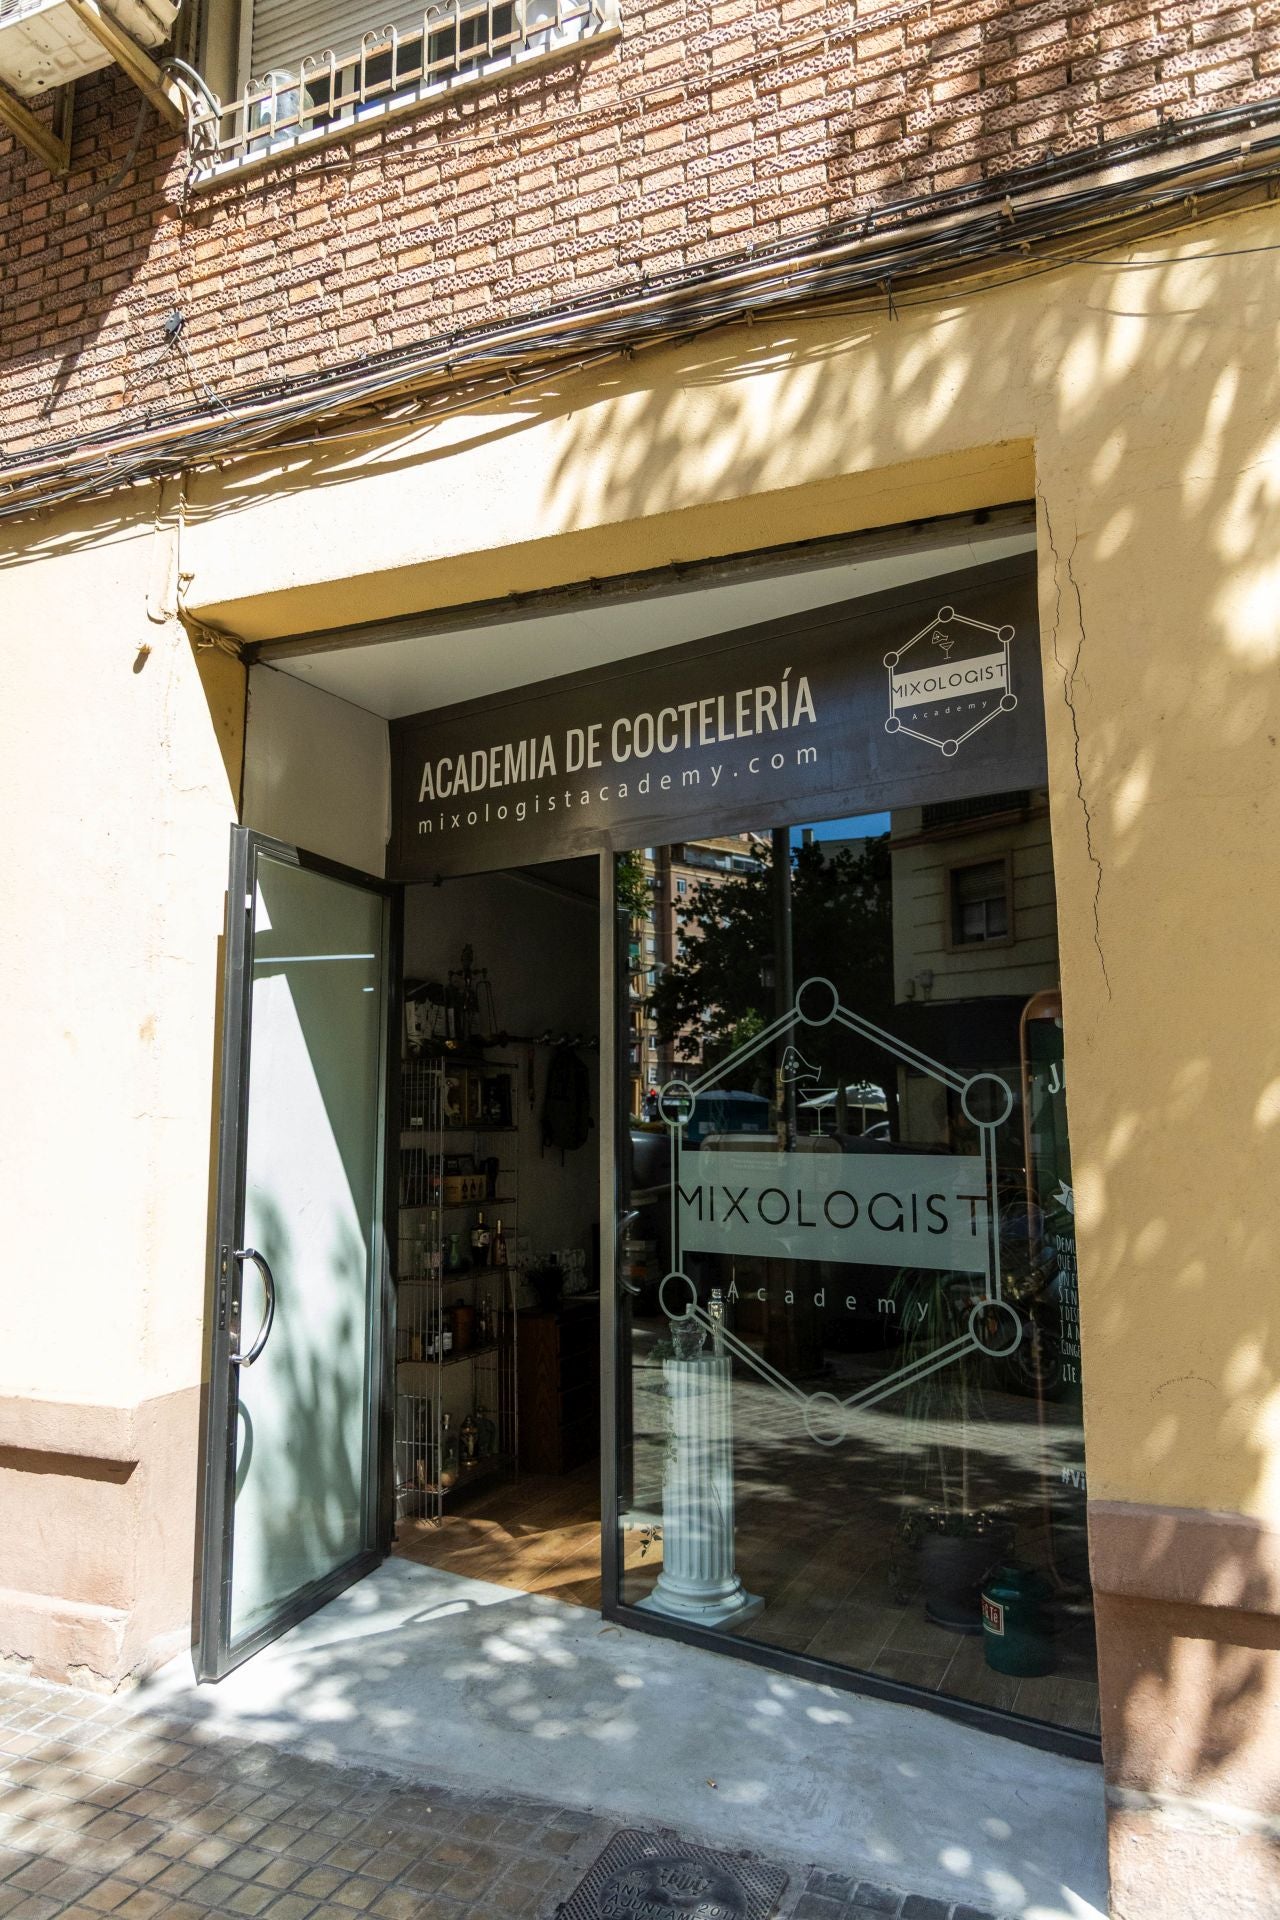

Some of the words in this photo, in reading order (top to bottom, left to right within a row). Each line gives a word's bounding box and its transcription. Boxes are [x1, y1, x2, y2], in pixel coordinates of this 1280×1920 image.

[892, 663, 1007, 698] MIXOLOGIST
[912, 701, 987, 720] Academy
[418, 734, 557, 803] ACADEMIA
[565, 723, 603, 773] DE
[611, 666, 817, 763] COCTELERÍA
[418, 746, 817, 835] mixologistacademy.com
[1048, 1059, 1067, 1094] J
[678, 1184, 989, 1237] MIXOLOGIST
[727, 1280, 929, 1322] Academy
[609, 1882, 647, 1897] ANY
[697, 1903, 738, 1920] 2011
